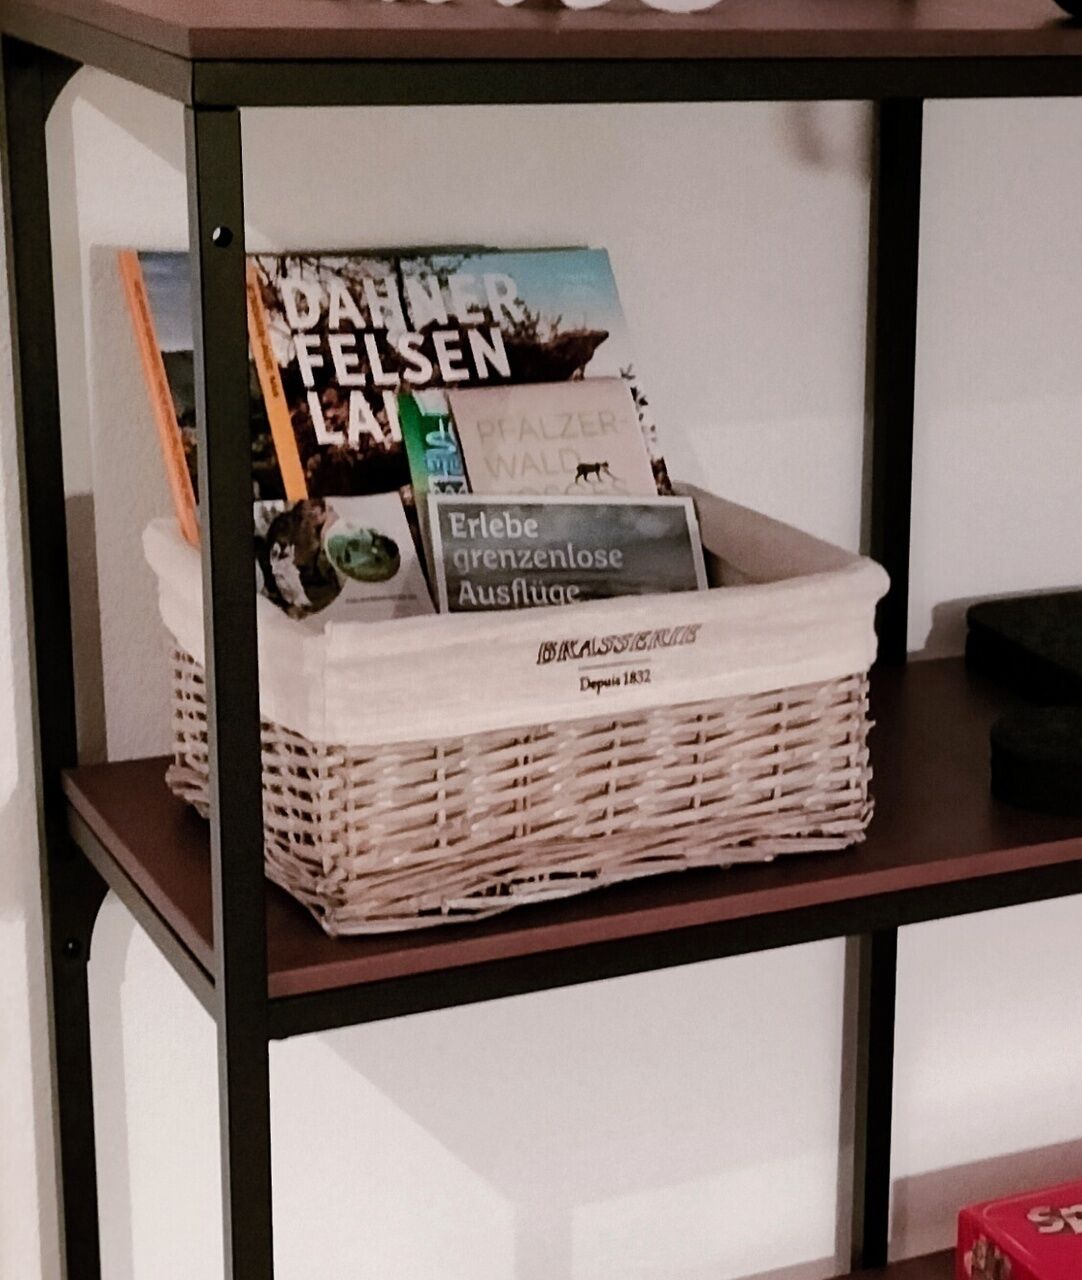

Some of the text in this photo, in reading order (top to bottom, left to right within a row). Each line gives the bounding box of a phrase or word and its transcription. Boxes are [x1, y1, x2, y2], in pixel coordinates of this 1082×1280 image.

[279, 273, 526, 331] DAHNER
[295, 328, 511, 388] FELSEN
[482, 446, 582, 481] WALD
[448, 511, 539, 539] Erlebe
[453, 542, 624, 576] grenzenlose
[458, 576, 581, 607] Ausflüge
[536, 623, 703, 666] BRASSERIE
[578, 673, 621, 696] Depuis
